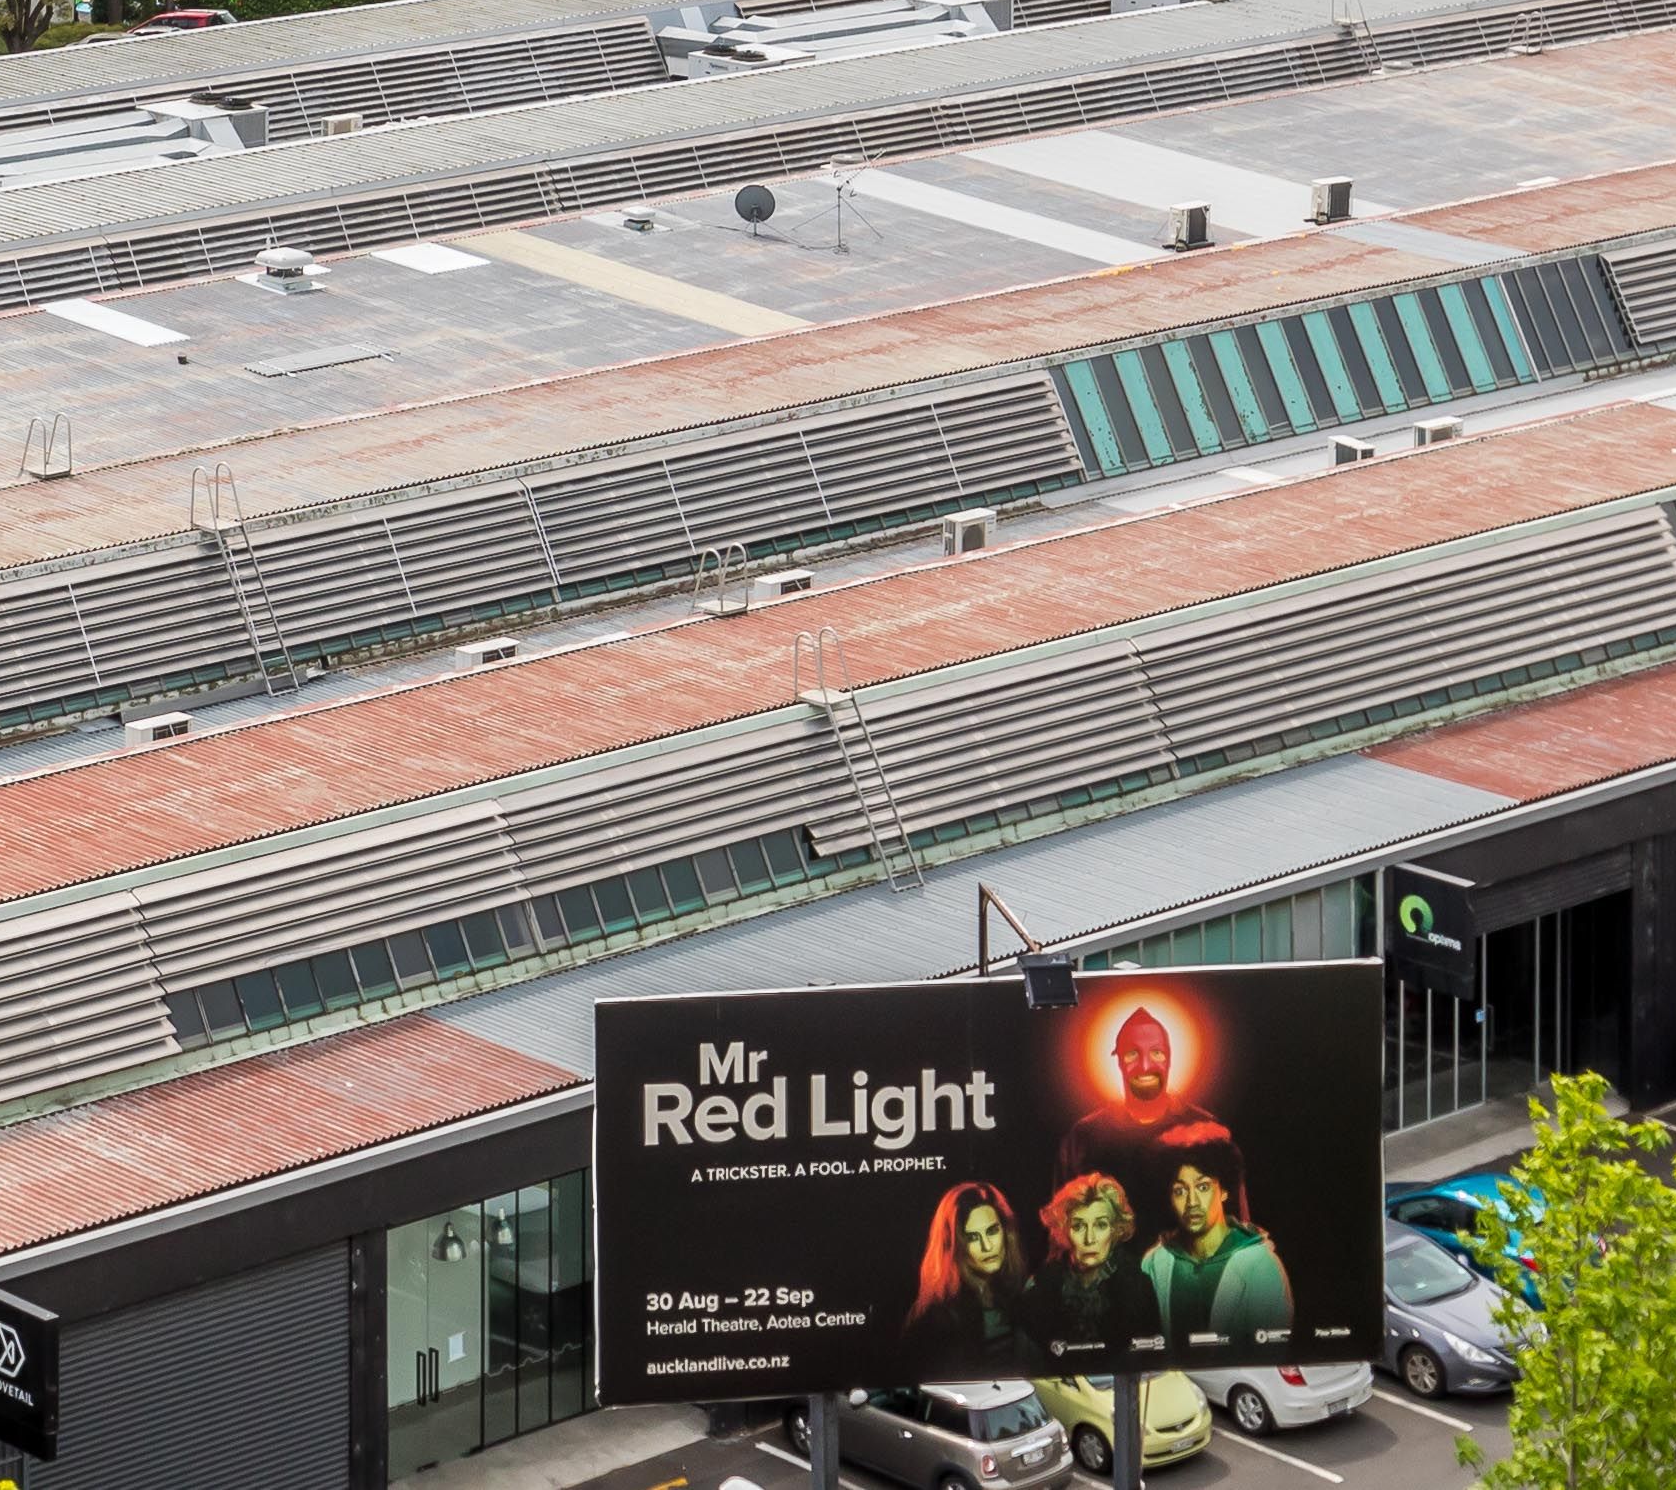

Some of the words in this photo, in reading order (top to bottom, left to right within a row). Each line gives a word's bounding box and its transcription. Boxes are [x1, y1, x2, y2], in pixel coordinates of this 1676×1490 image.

[699, 1041, 768, 1086] Mr
[643, 1075, 788, 1147] Red
[810, 1068, 997, 1150] Light
[691, 1168, 703, 1183] A
[707, 1164, 791, 1182] TRICKSTER.
[795, 1162, 807, 1177] A
[810, 1160, 855, 1177] FOOL.
[858, 1159, 871, 1174] A
[874, 1155, 947, 1173] PROPHET.
[646, 1292, 673, 1312] 30
[678, 1291, 719, 1313] Aug
[744, 1287, 771, 1307] 22
[775, 1286, 815, 1308] Sep
[647, 1319, 697, 1336] Herald
[701, 1317, 763, 1334] Theatre,
[766, 1314, 811, 1330] Aotea
[815, 1311, 867, 1328] Centre
[646, 1354, 791, 1376] aucklandlive.co.nz
